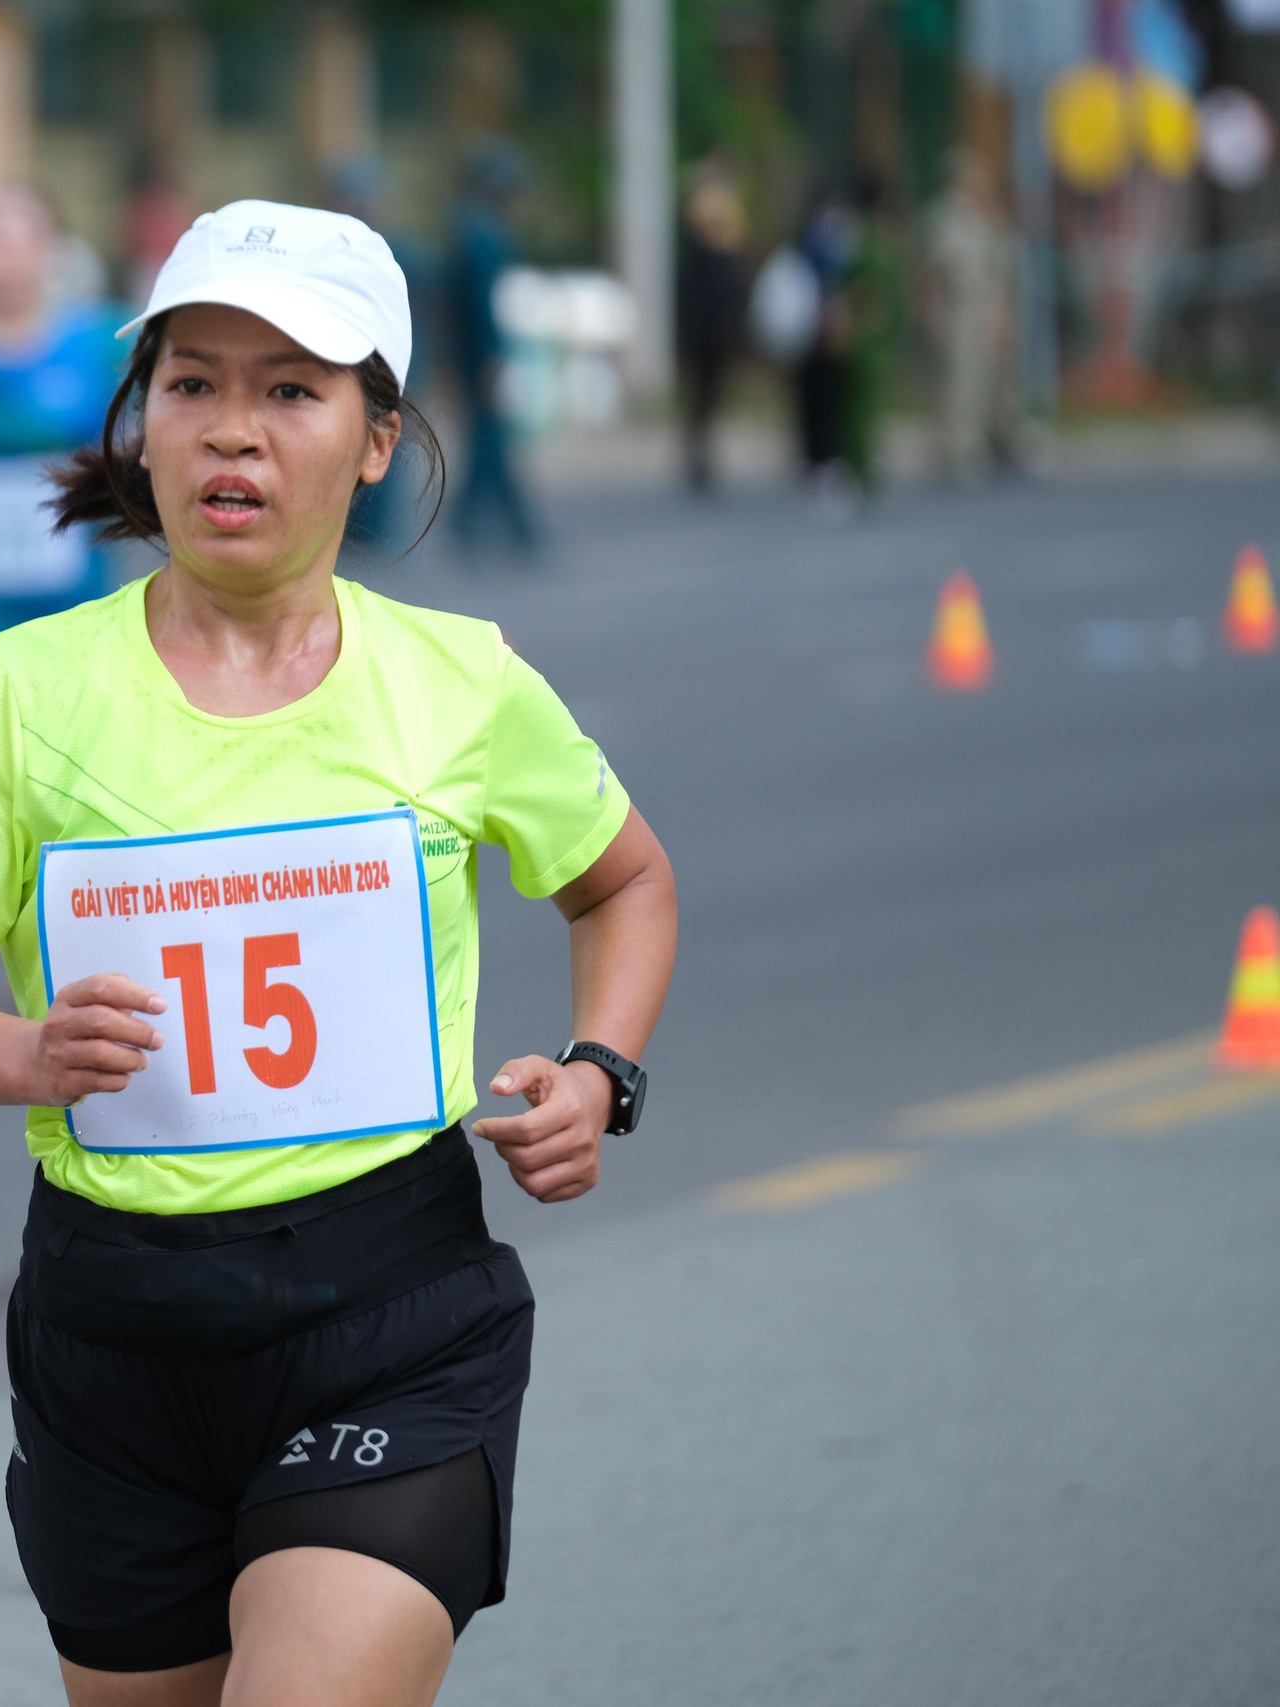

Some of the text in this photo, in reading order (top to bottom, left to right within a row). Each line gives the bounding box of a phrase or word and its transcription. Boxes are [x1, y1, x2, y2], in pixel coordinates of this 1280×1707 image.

[71, 879, 102, 918] GIẢI
[105, 881, 139, 922] VIỆT
[169, 873, 221, 915] HUYỆN
[222, 870, 259, 906] BÌNH
[262, 865, 314, 902] CHÁNH
[355, 860, 390, 892] 2024
[161, 932, 318, 1095] 15
[329, 1423, 389, 1466] T8
